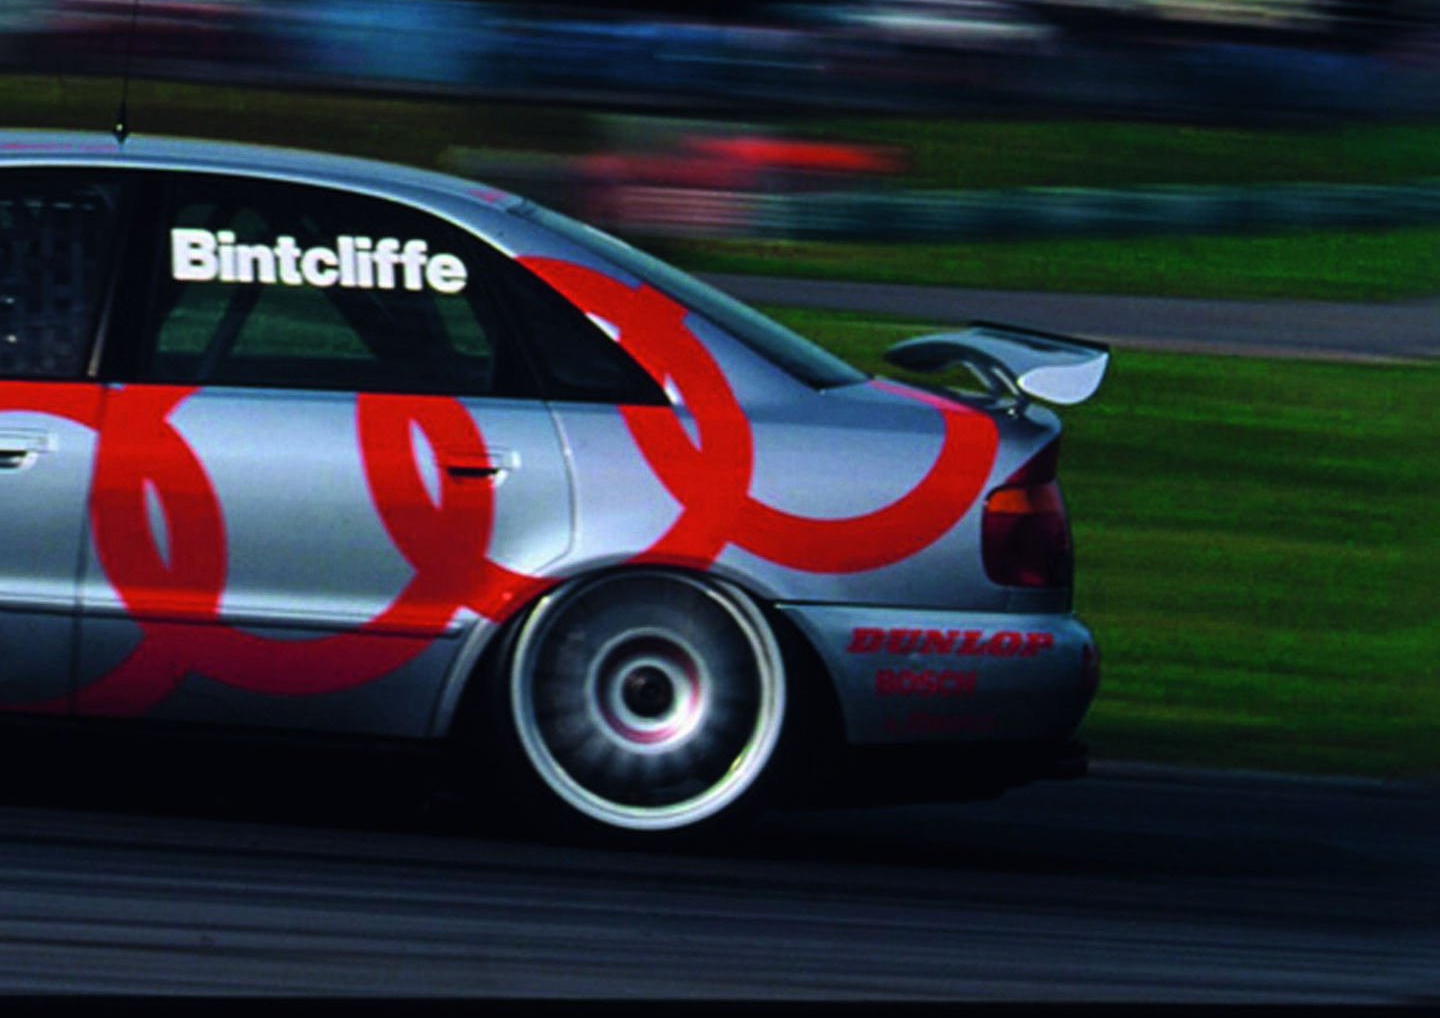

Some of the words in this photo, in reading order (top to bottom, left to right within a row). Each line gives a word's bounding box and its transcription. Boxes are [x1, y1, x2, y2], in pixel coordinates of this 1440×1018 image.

[170, 228, 468, 293] Bintcliffe
[848, 628, 1054, 656] DUNLOP
[875, 669, 978, 697] BOSCH
